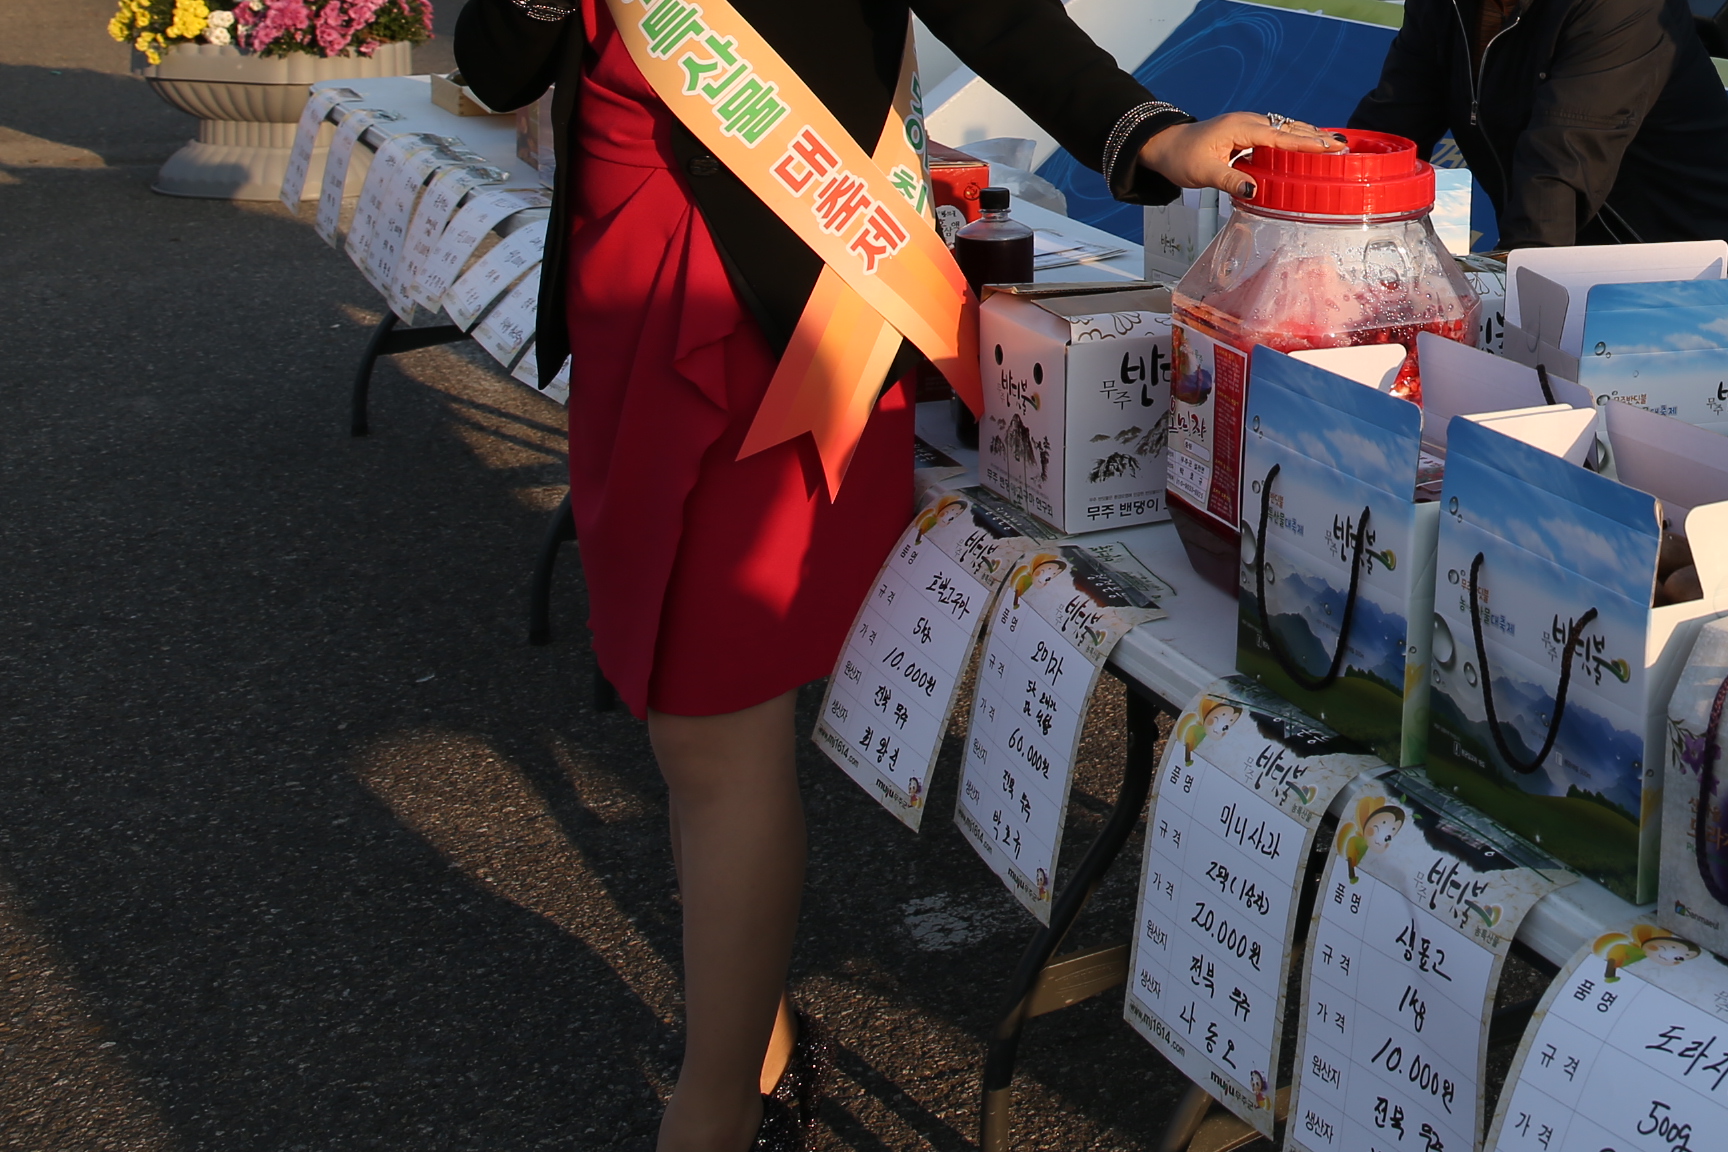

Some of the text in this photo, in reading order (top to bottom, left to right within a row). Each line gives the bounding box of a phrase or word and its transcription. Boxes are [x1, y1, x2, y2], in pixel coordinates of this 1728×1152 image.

[774, 128, 907, 272] 대축제
[1087, 498, 1158, 520] 무주 밴댕이
[845, 660, 863, 684] 원산지
[831, 699, 848, 723] 생산자
[972, 736, 989, 766] 원산지
[965, 779, 981, 806] 생산자
[1220, 803, 1282, 862] 미니사과
[1427, 857, 1503, 930] 반딧불
[1146, 918, 1168, 952] 원산지
[1685, 906, 1720, 930] Sanmaeul
[1139, 967, 1161, 1001] 생산자
[1311, 1054, 1341, 1090] 원산지
[1373, 1095, 1406, 1141] 전북
[1305, 1108, 1335, 1145] 생산자
